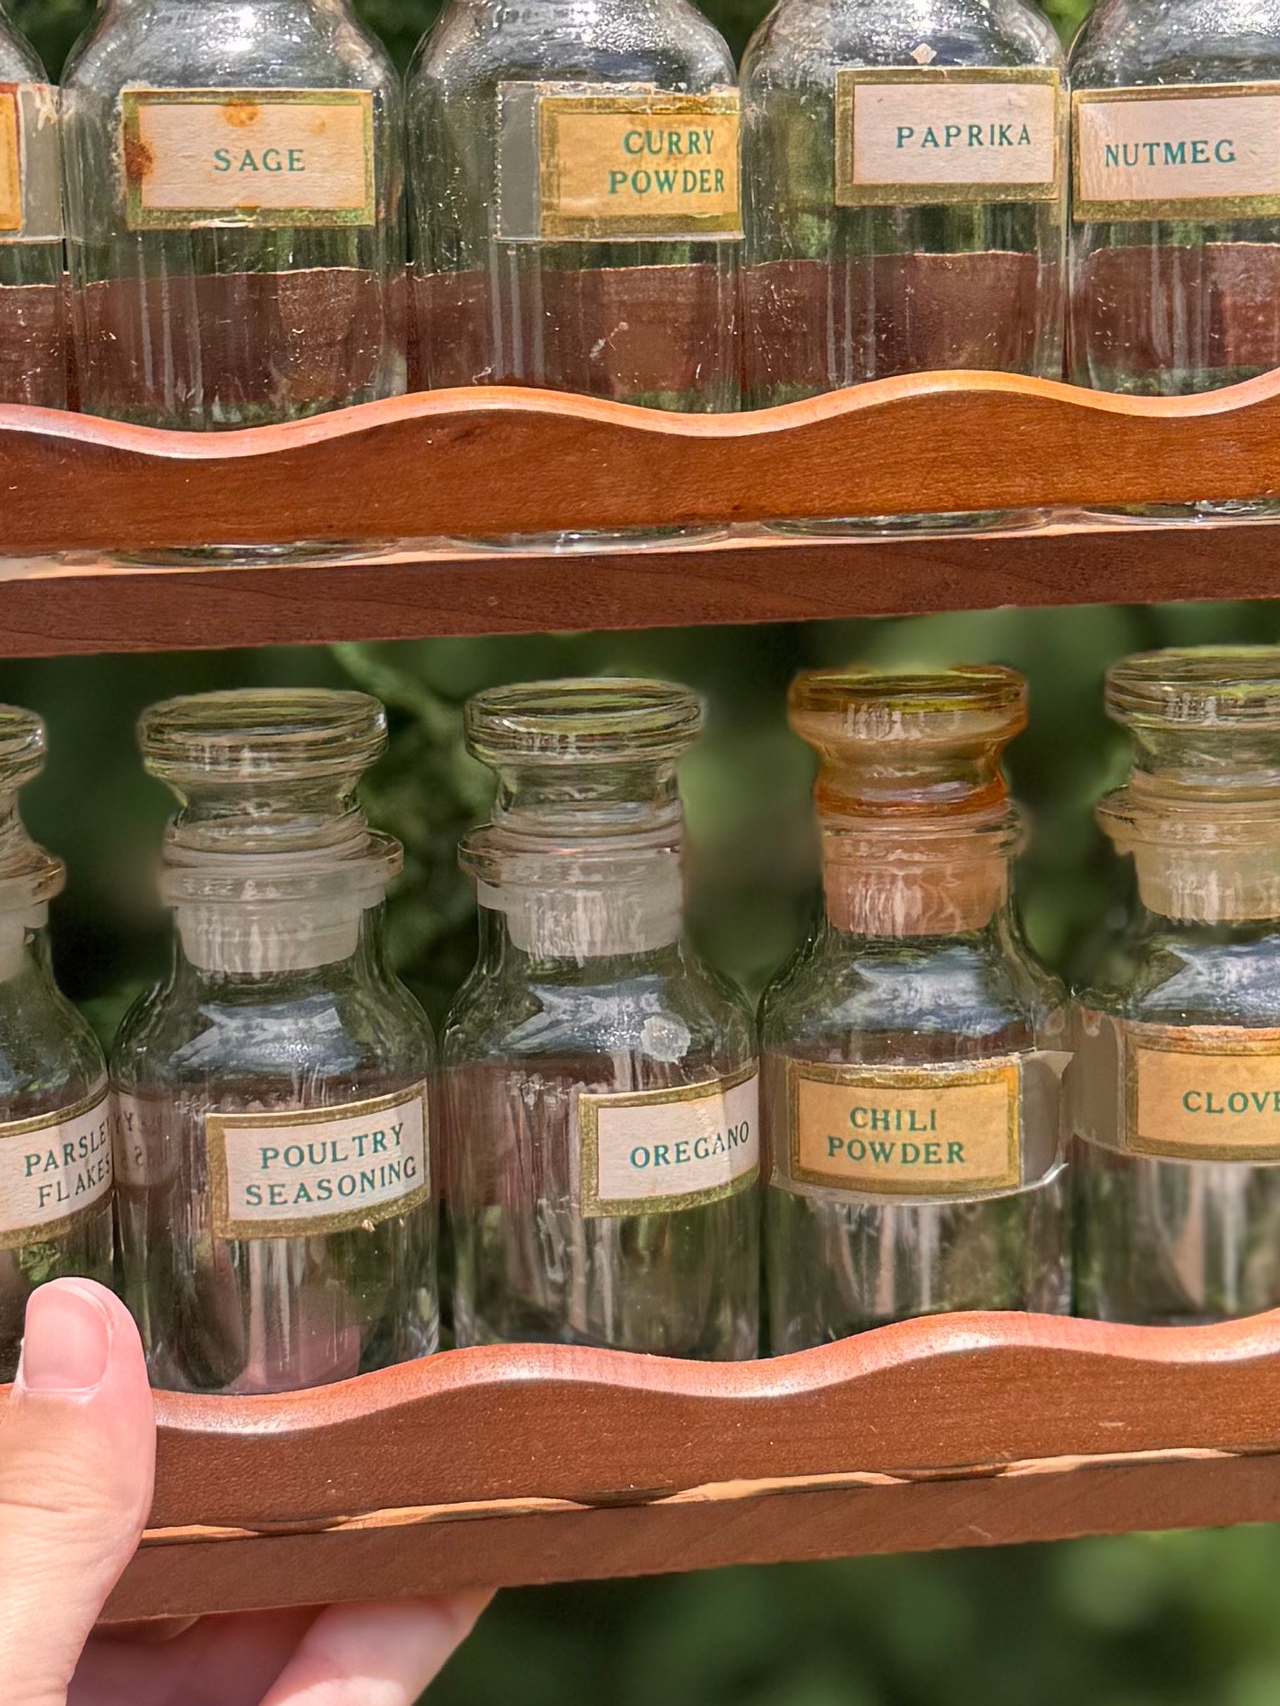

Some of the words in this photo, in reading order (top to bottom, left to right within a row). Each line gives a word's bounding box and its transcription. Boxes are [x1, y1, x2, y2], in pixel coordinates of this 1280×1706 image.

[623, 129, 716, 156] CURRY
[896, 124, 1032, 149] PAPRIKA
[213, 147, 306, 173] SAGE
[1104, 139, 1237, 168] NUTMEG
[608, 168, 726, 196] POWDER
[849, 1110, 938, 1132] CHILI
[260, 1123, 405, 1170] POULTRY
[629, 1122, 750, 1170] OREGANO
[827, 1137, 965, 1166] POWDER
[245, 1157, 417, 1208] SEASONING
